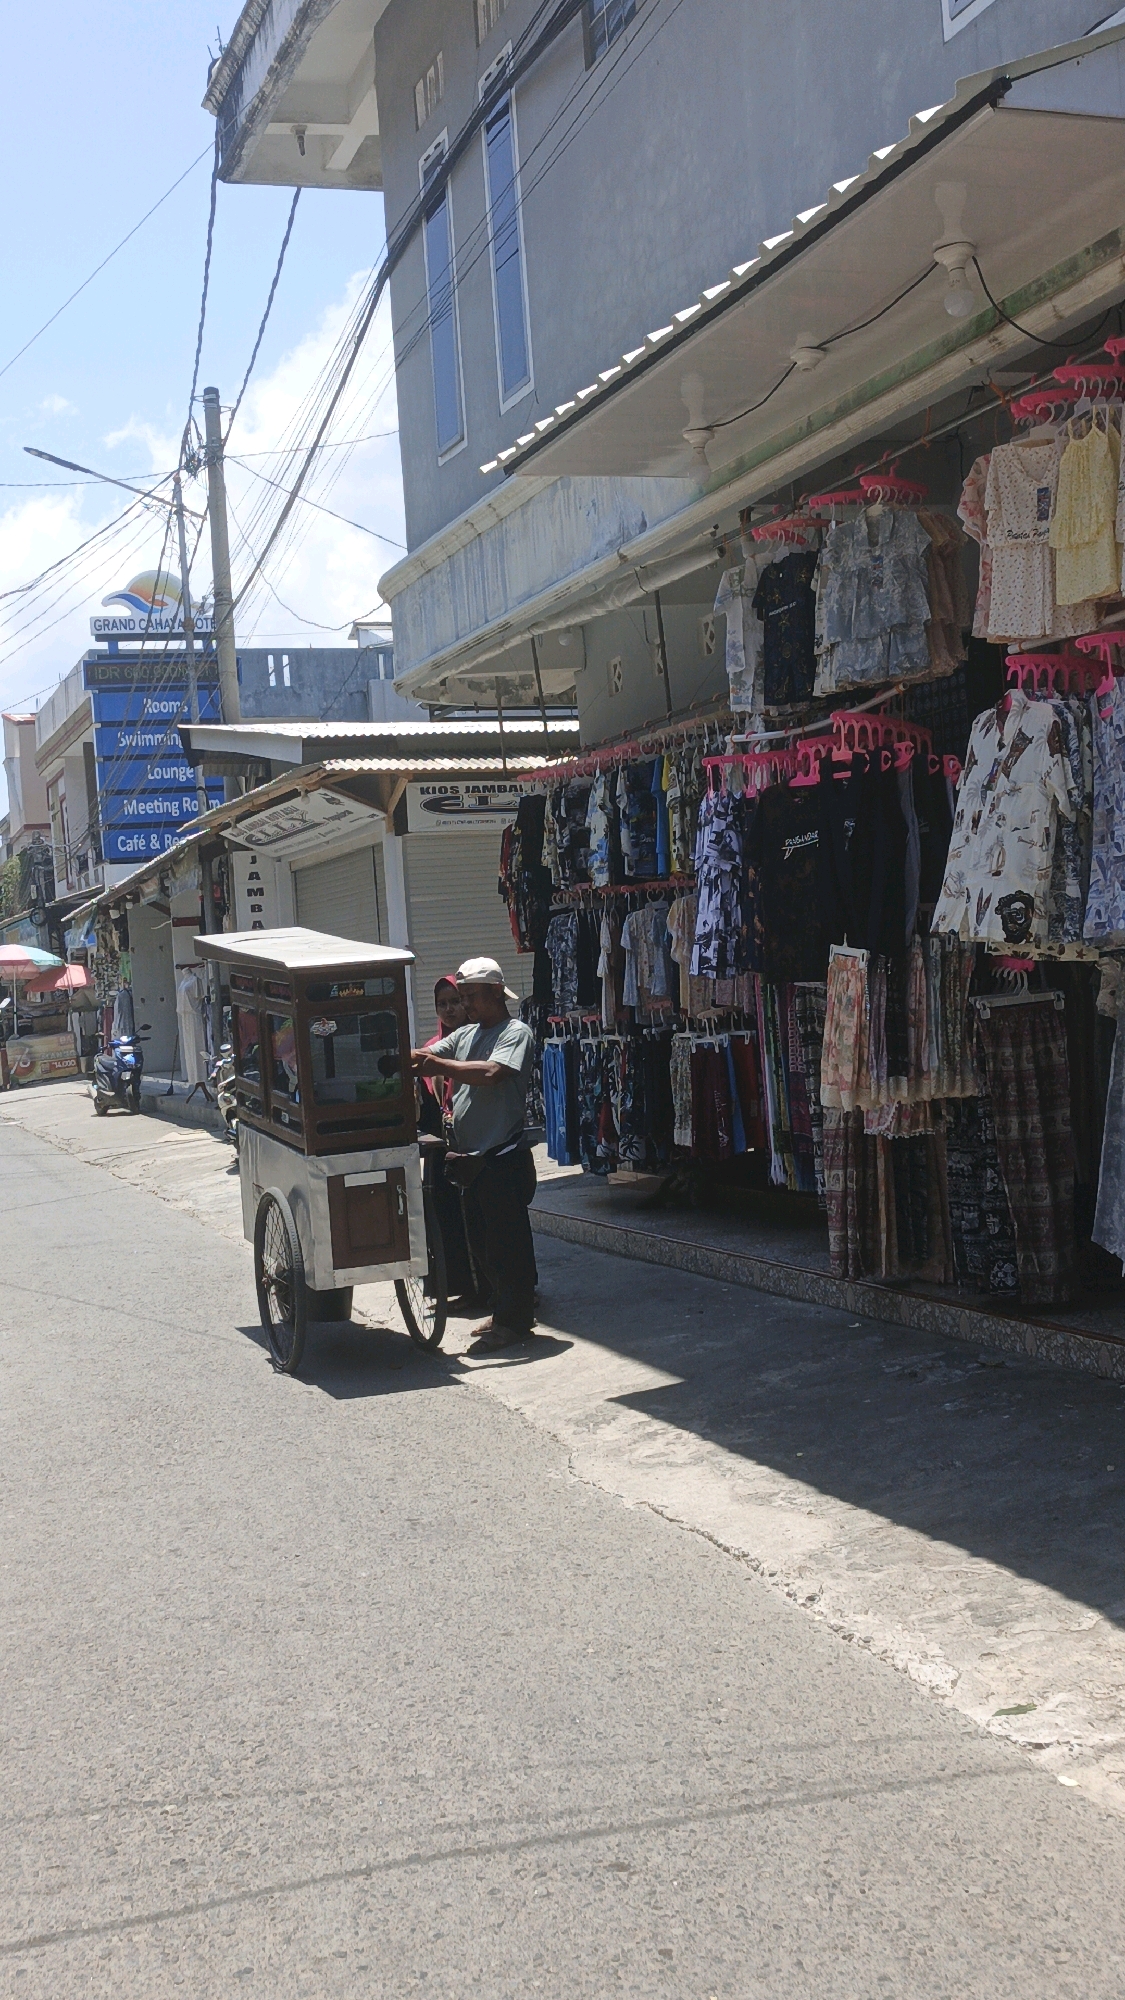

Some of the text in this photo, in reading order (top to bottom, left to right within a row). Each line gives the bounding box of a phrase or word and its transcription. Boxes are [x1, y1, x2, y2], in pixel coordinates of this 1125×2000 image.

[93, 618, 136, 632] GRAND
[138, 618, 183, 631] CAHAYA
[144, 698, 189, 714] Rooms
[147, 764, 194, 782] Lounge
[420, 785, 460, 795] KIOS
[124, 797, 221, 817] Meeting Rom
[118, 834, 147, 852] Café
[150, 834, 160, 849] &
